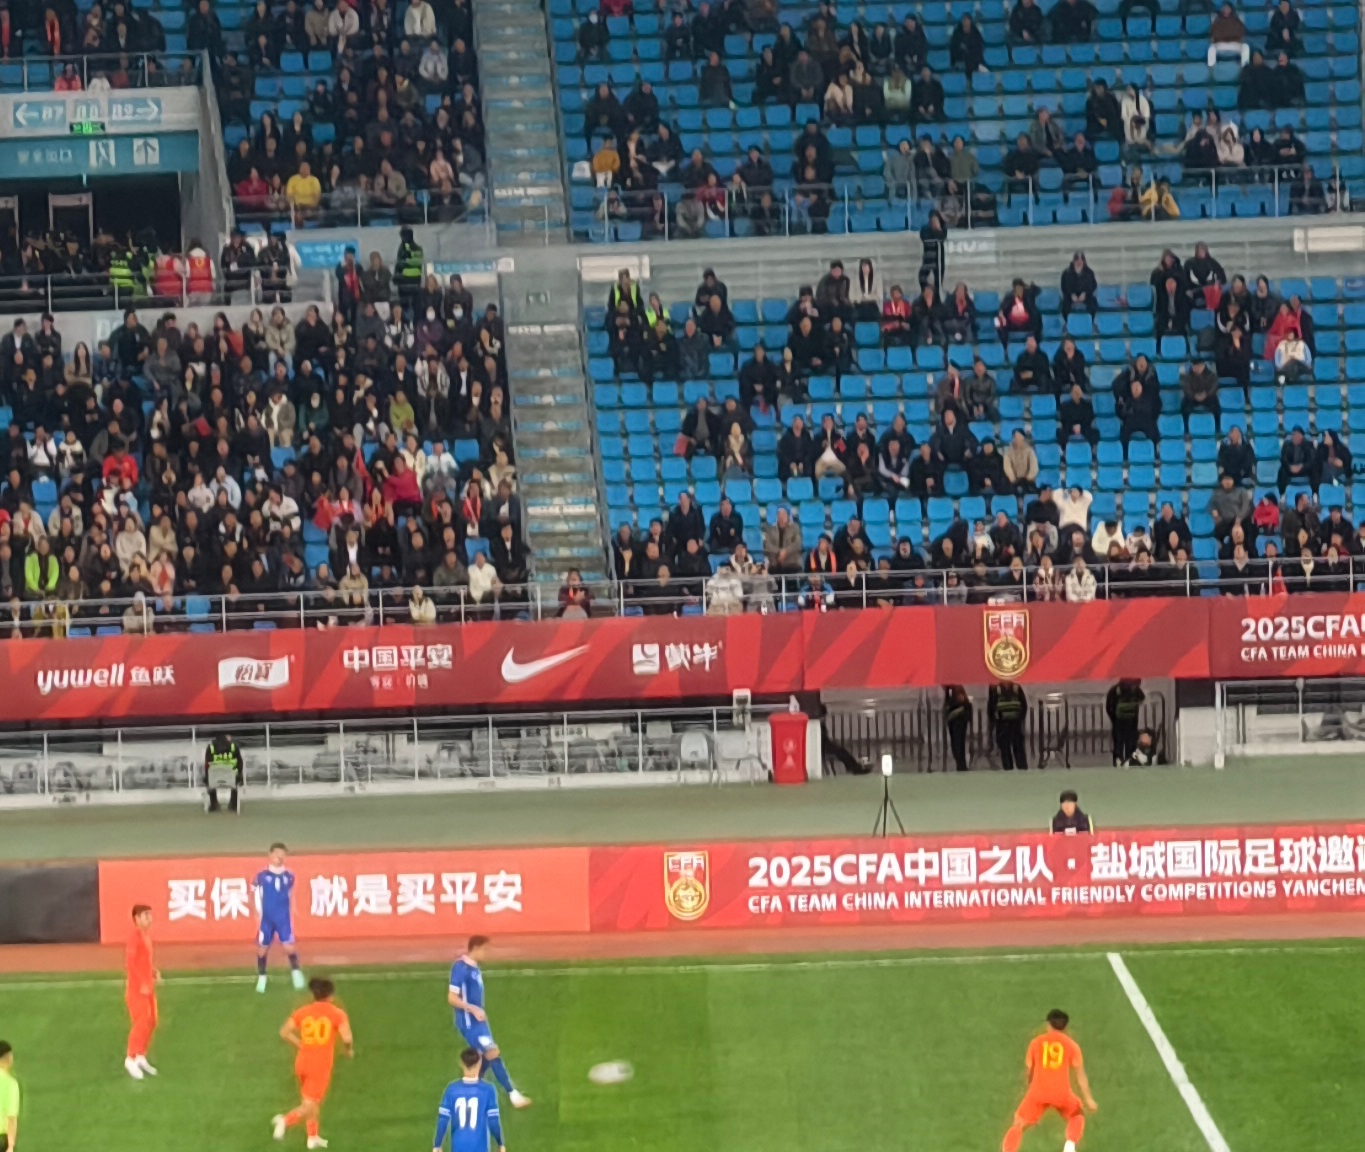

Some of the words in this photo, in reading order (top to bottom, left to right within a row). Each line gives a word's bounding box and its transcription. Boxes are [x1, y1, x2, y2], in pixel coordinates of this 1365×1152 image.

[1241, 613, 1365, 642] 2025CFA
[1313, 642, 1357, 659] CHINA
[38, 663, 124, 694] yuwell
[168, 877, 262, 920] 买保
[310, 870, 523, 917] 就是买平安
[748, 895, 782, 914] CFA
[788, 893, 837, 913] TEAM
[842, 892, 899, 911] CHINA
[904, 886, 1046, 910] INTERNATIONAL
[1051, 884, 1136, 905] FRIENDLY
[1140, 879, 1276, 902] COMPETITIONS
[301, 1016, 332, 1045] 20
[1042, 1041, 1064, 1070] 19
[455, 1097, 478, 1130] 11
